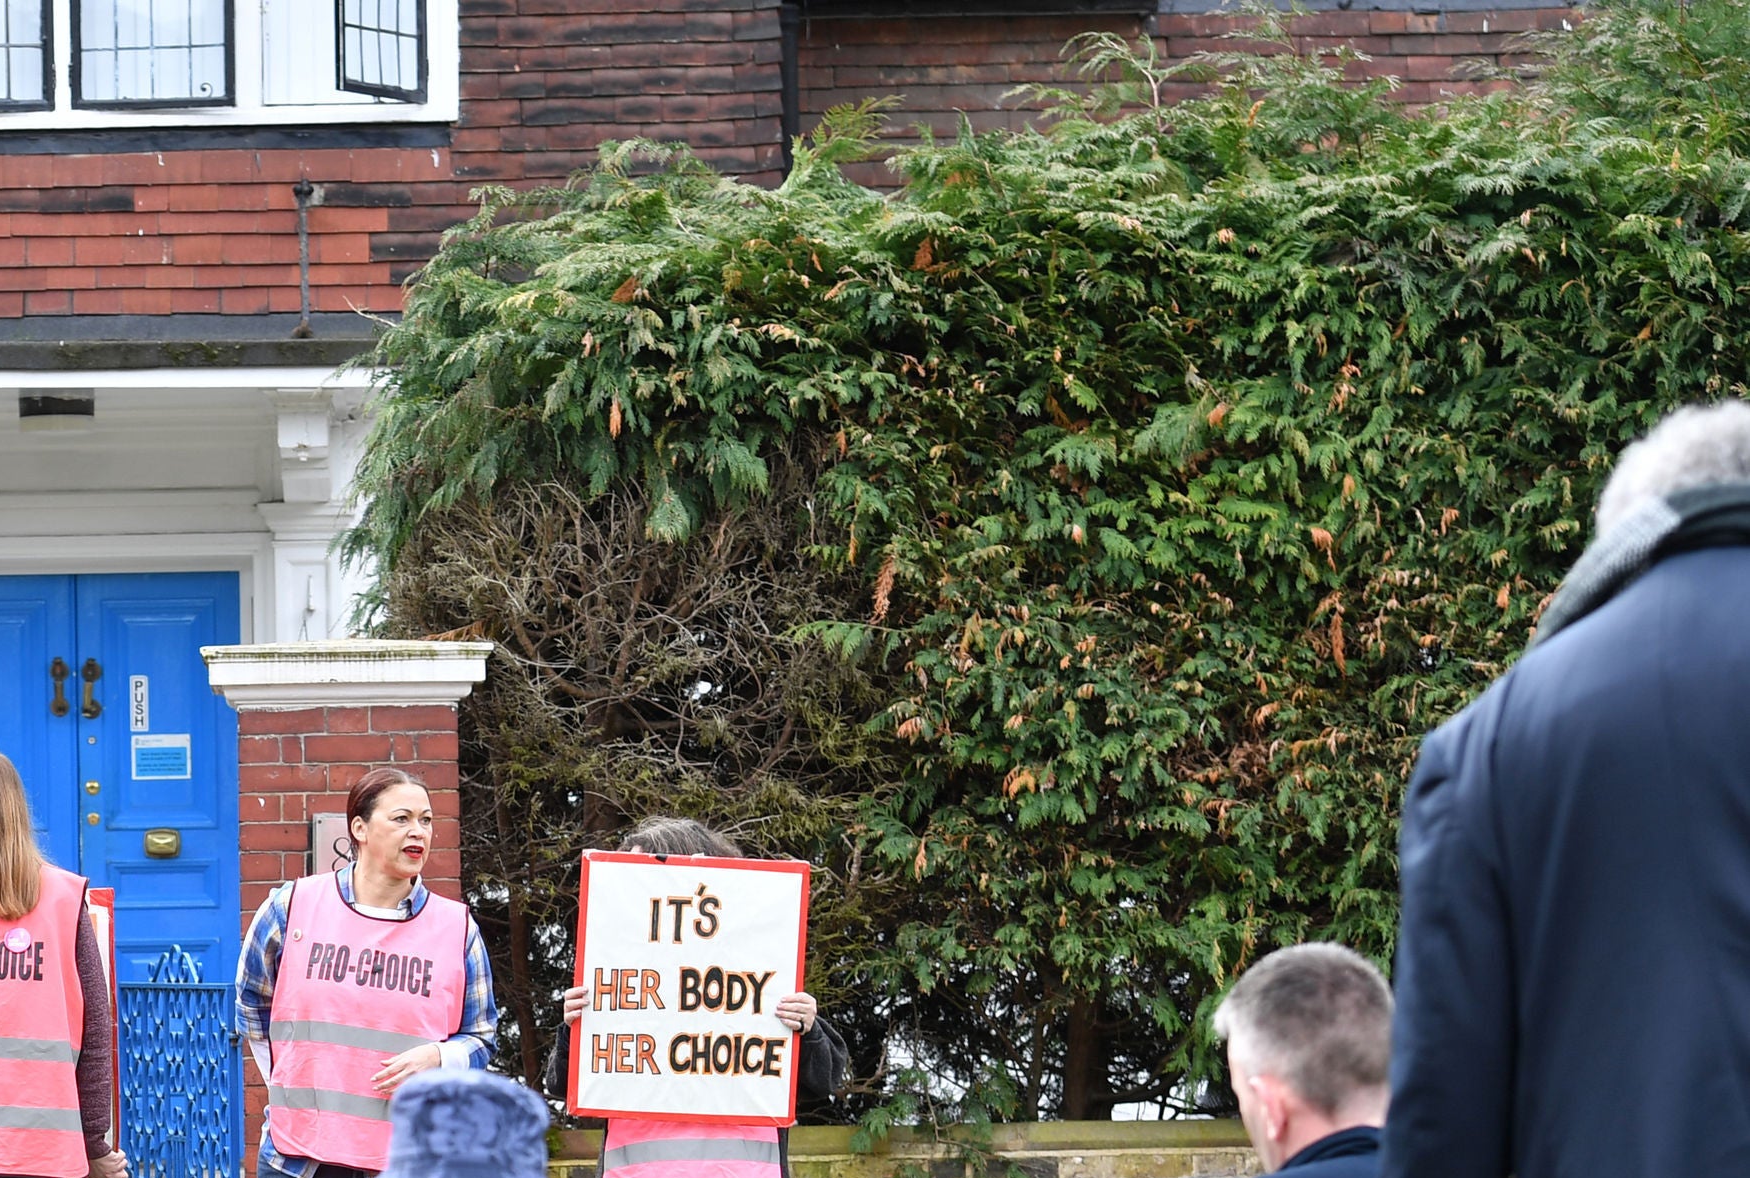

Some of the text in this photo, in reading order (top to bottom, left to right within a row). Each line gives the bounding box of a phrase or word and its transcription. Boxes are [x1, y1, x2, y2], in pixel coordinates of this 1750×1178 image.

[134, 680, 144, 727] PUSH
[648, 882, 722, 944] IT'S
[305, 942, 434, 998] PRO-CHOICE
[593, 965, 777, 1015] HER BODY
[591, 1030, 788, 1078] HER CHOICE
